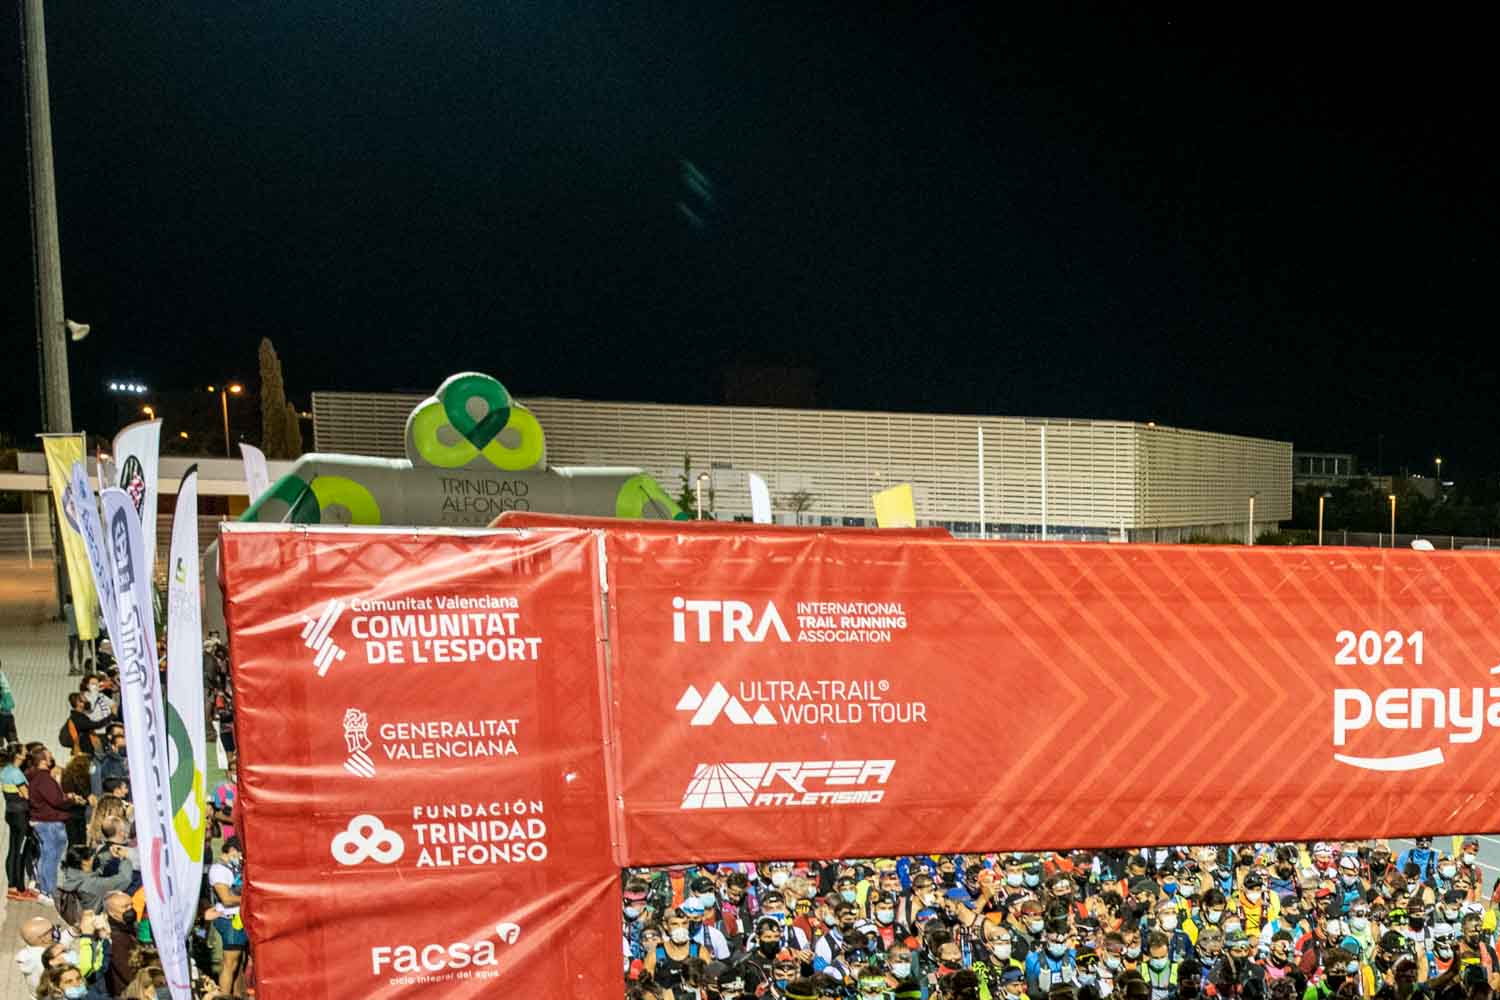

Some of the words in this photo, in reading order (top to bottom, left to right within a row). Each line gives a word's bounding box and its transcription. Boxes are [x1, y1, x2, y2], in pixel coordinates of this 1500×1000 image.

[441, 479, 529, 496] TRINIDAD
[442, 496, 530, 512] ALFONSO
[351, 597, 431, 611] Comunitat
[436, 596, 519, 609] Valenciana
[797, 602, 905, 615] INTERNATIONAL
[351, 613, 520, 640] COMUNITAT
[797, 616, 836, 629] TRAIL
[840, 616, 907, 629] RUNNING
[797, 630, 891, 643] ASSOCIATION
[367, 640, 405, 664] DE
[412, 637, 543, 663] L'ESPORT
[1335, 629, 1424, 665] 2021
[780, 703, 862, 724] WORLD
[868, 703, 927, 723] TOUR
[380, 719, 520, 740] GENERALITAT
[383, 740, 518, 760] VALENCIANA
[761, 759, 896, 792] RFEA
[754, 790, 884, 807] ATLETISMO
[413, 800, 544, 818] FUNDACIÓN
[413, 819, 546, 844] TRINIDAD
[416, 842, 547, 868] ALFONSO
